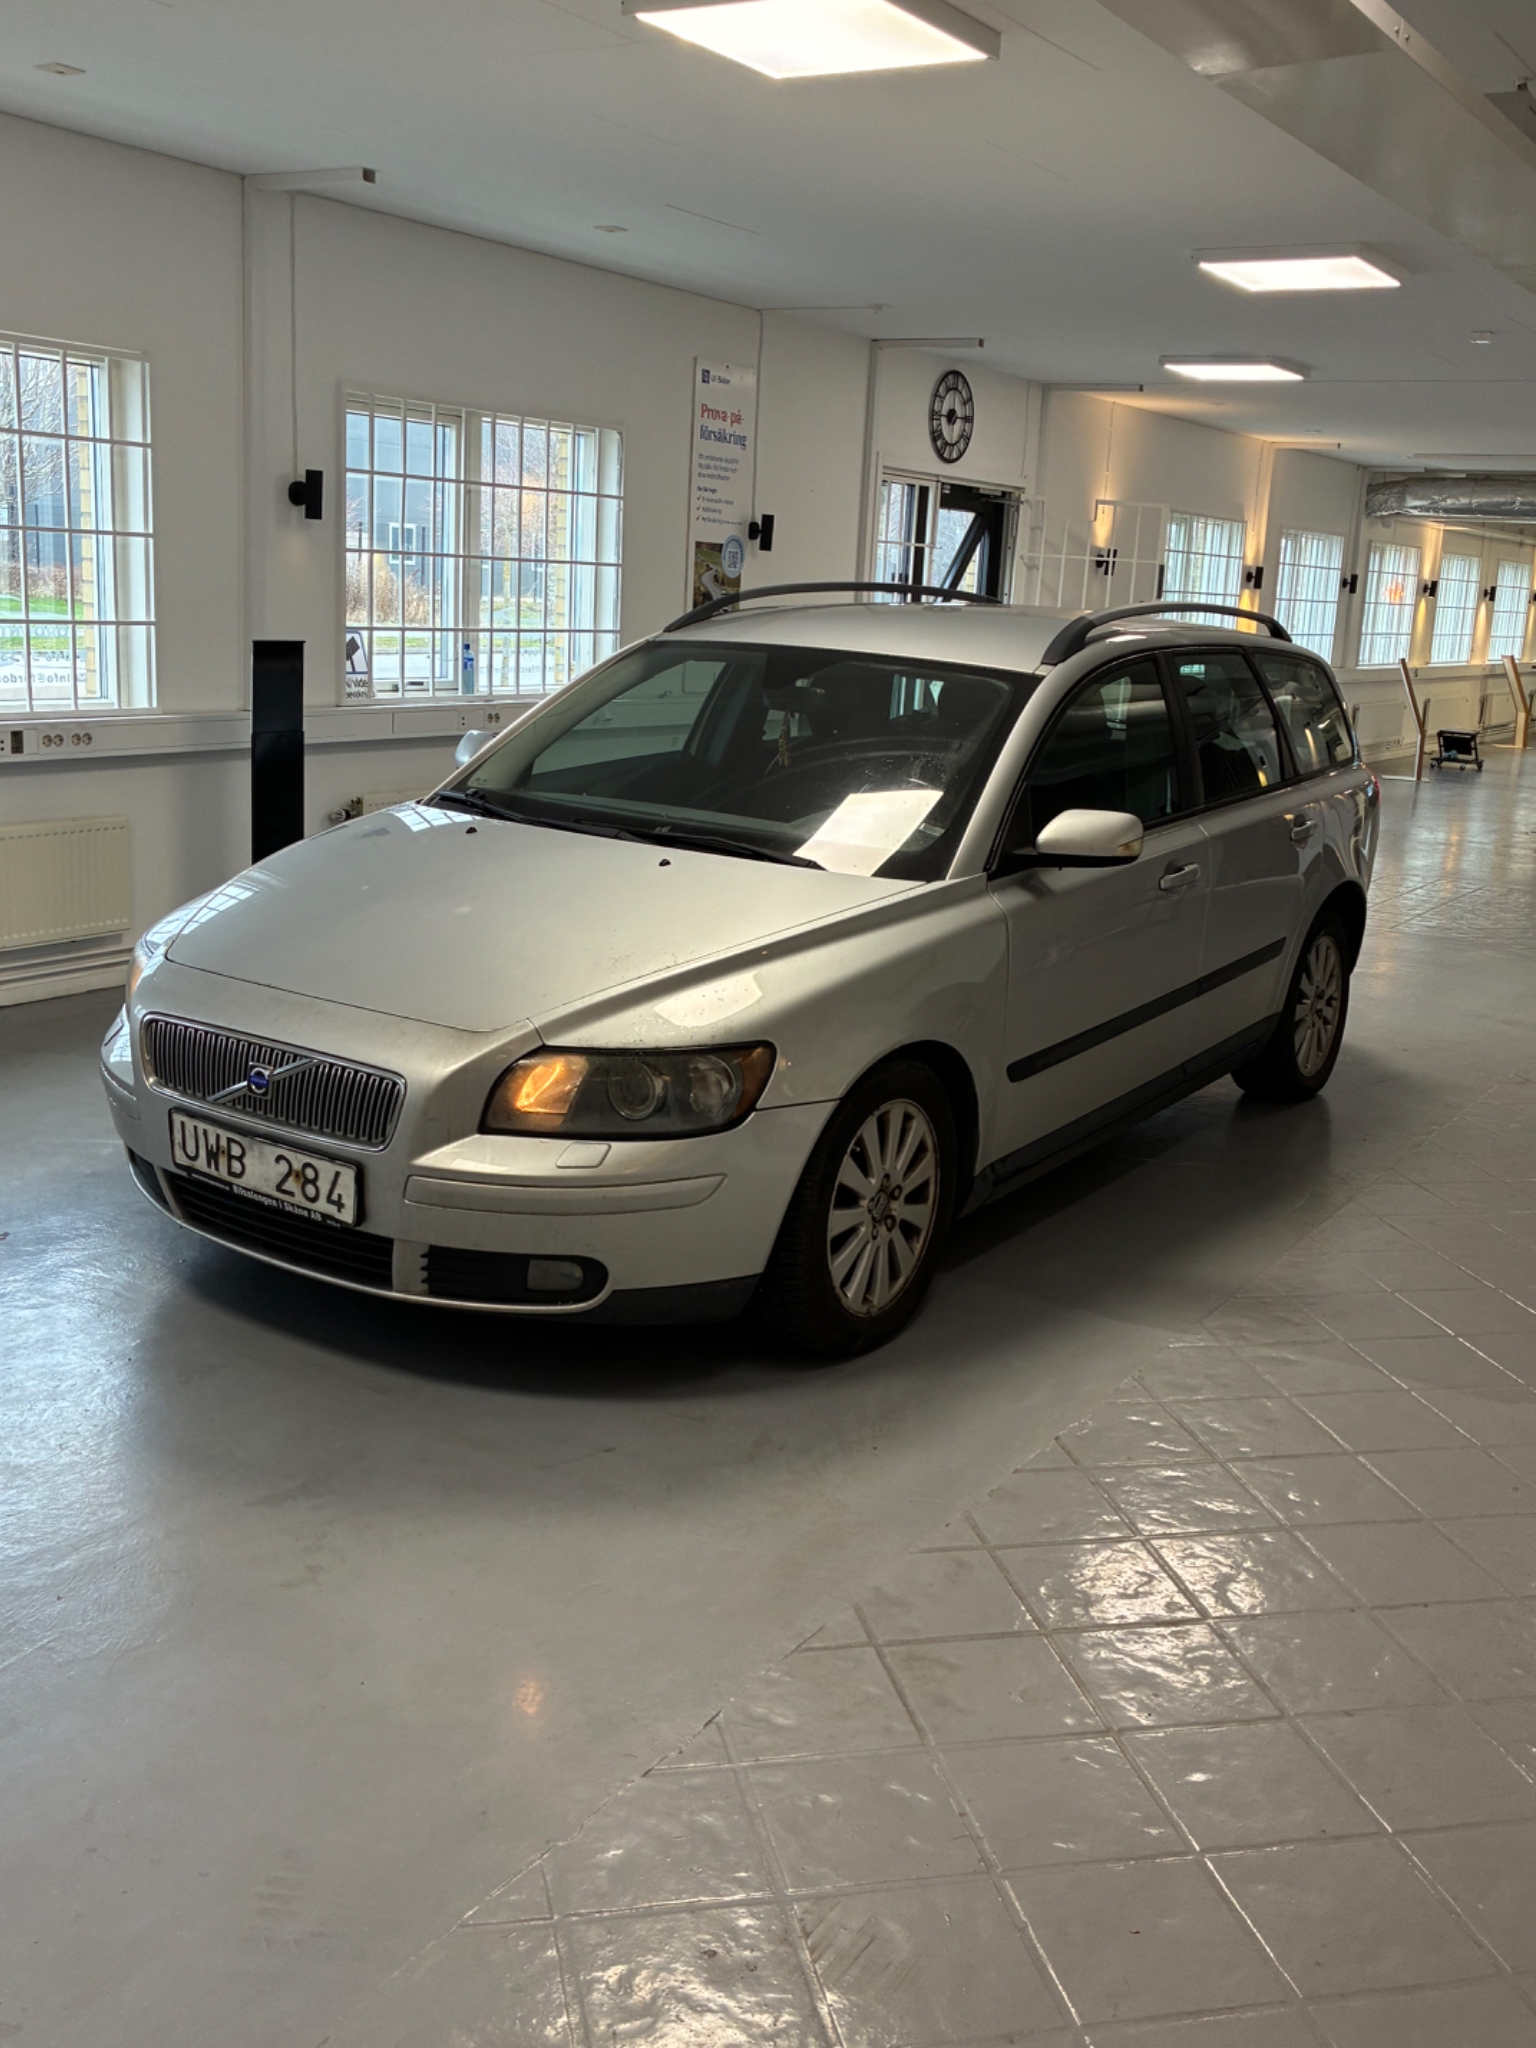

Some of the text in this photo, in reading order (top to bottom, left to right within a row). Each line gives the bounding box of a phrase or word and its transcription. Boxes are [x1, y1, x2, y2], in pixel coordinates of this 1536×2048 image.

[699, 424, 748, 451] försäkring
[180, 1120, 346, 1214] UWB 284
[284, 1201, 309, 1218] Skåne
[310, 1210, 323, 1221] AB
